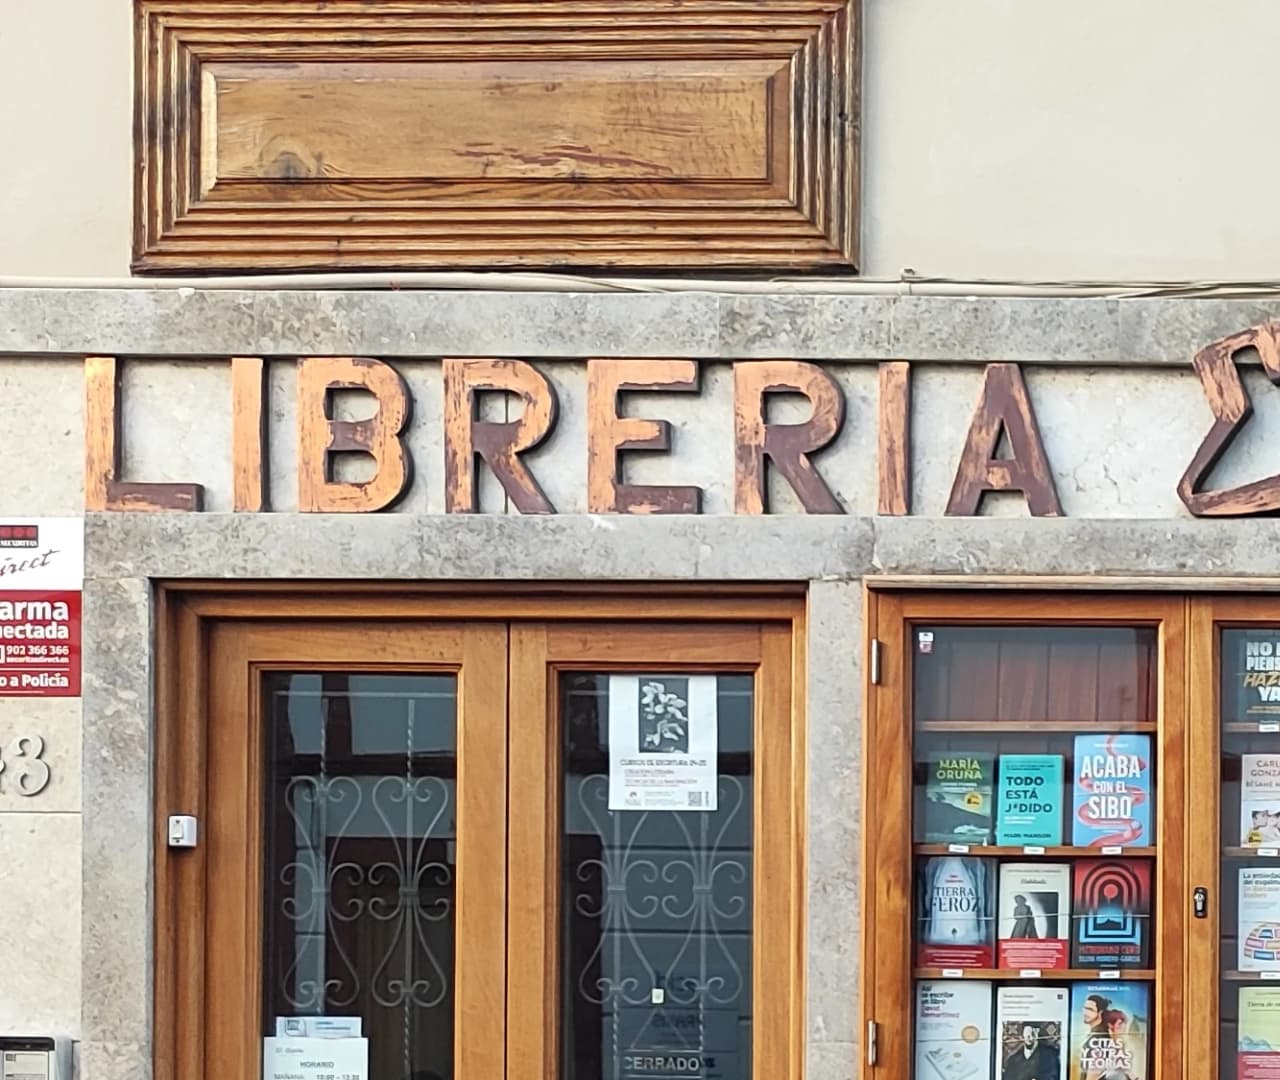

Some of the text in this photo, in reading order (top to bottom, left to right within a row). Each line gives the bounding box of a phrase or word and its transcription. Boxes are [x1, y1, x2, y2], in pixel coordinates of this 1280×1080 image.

[84, 357, 1066, 517] LIBRERIA
[7, 645, 69, 655] 902 366 366
[1246, 642, 1273, 656] NO
[22, 673, 69, 687] Policía
[1080, 755, 1142, 778] ACABA
[1006, 776, 1044, 786] TODO
[1093, 780, 1112, 793] CON
[1006, 788, 1038, 800] ESTÁ
[1088, 796, 1132, 819] SIBO
[1089, 1038, 1122, 1049] CITAS
[1091, 1049, 1132, 1059] OTRAS
[624, 1056, 699, 1071] CERRADO
